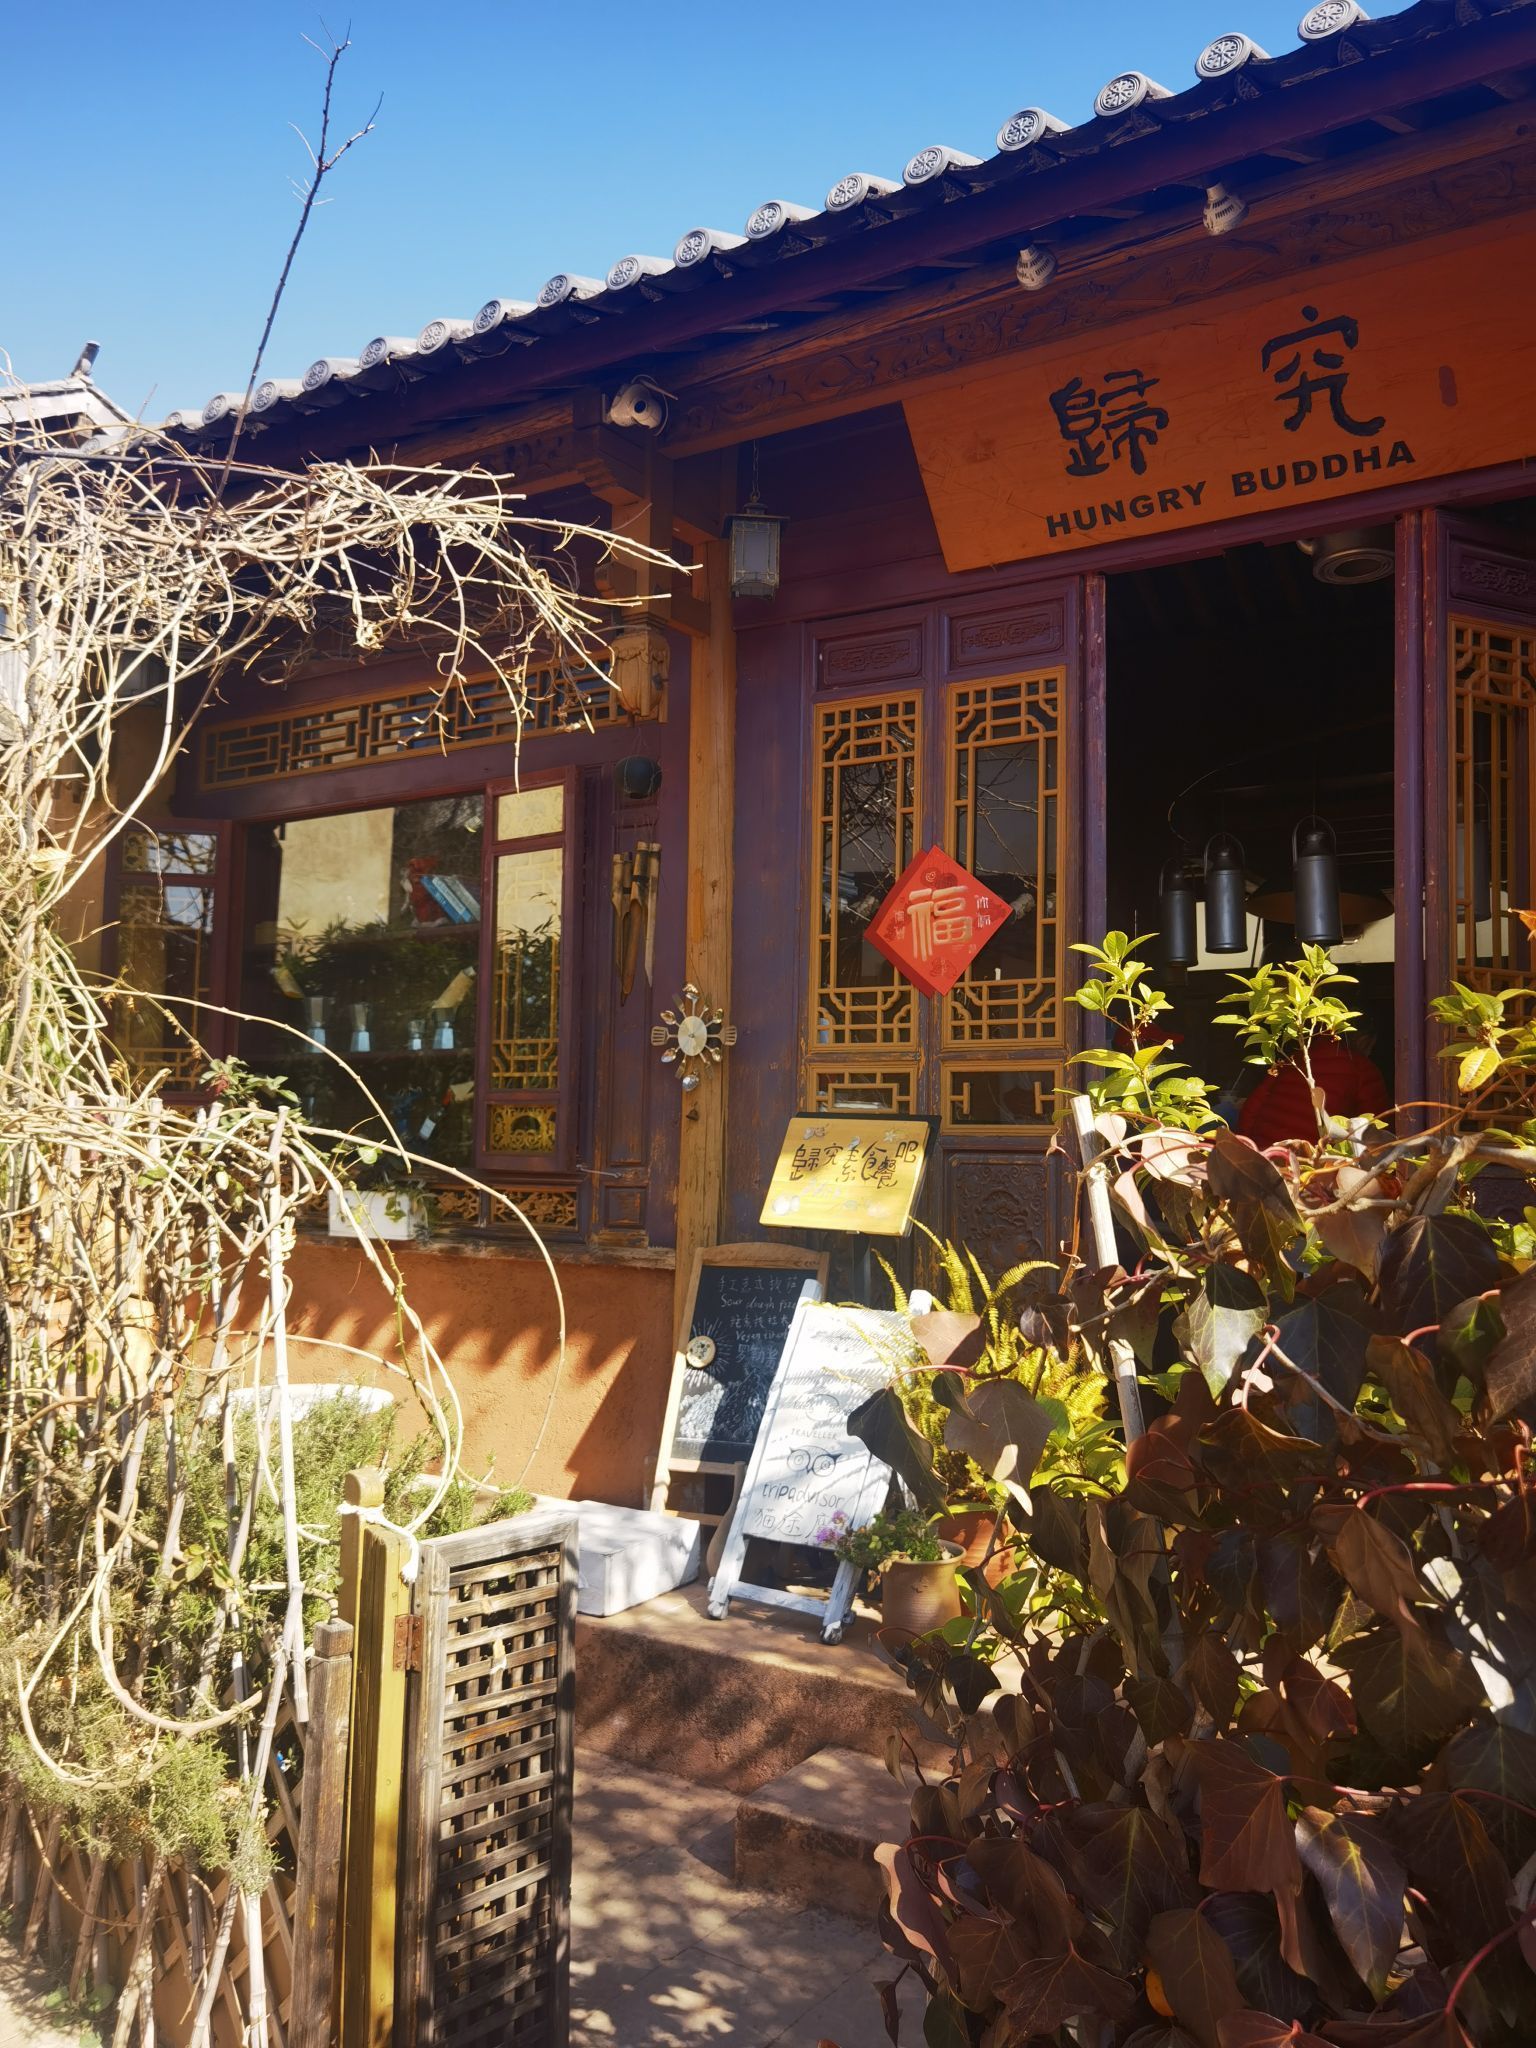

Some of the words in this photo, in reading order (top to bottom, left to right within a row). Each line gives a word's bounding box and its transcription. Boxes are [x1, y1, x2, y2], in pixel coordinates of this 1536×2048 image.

[1046, 481, 1206, 538] HUNGRY
[1231, 440, 1416, 498] BUDDHA
[907, 886, 973, 962] 福
[721, 1293, 744, 1308] Sour
[791, 1427, 838, 1441] TRAVELLER
[762, 1483, 845, 1509] tripadvisor
